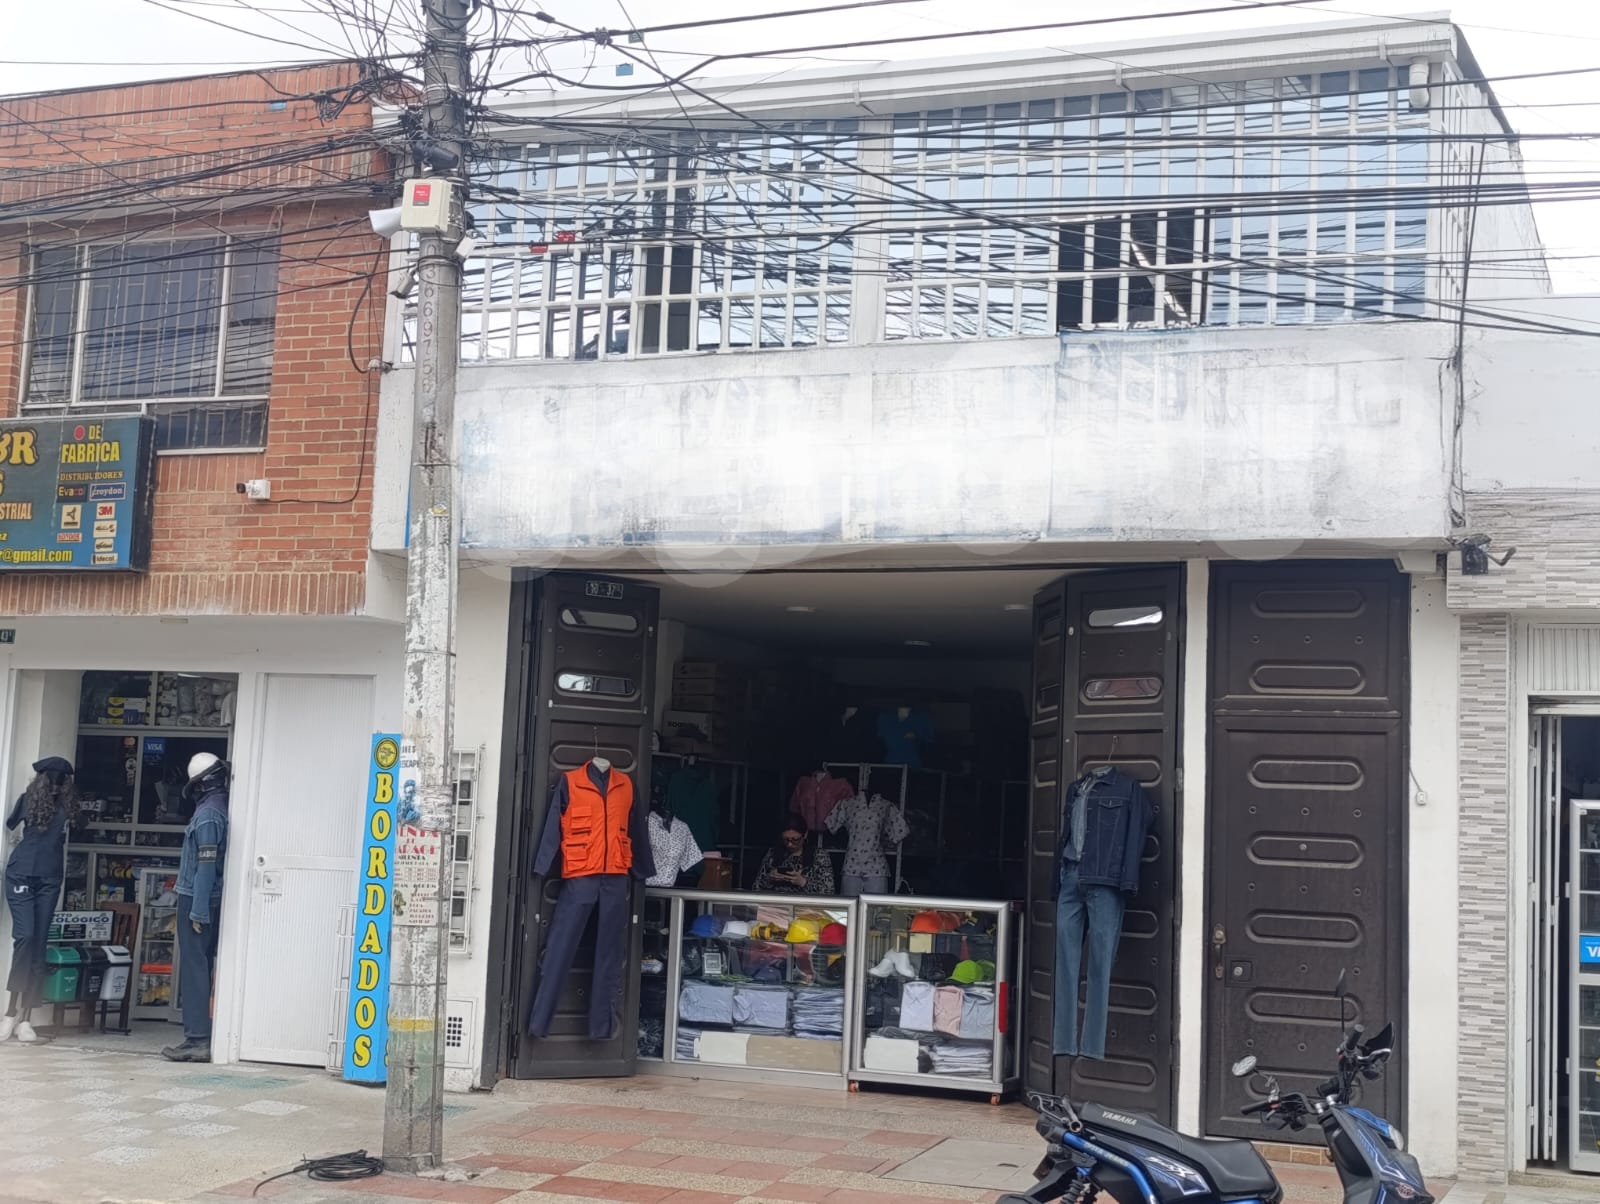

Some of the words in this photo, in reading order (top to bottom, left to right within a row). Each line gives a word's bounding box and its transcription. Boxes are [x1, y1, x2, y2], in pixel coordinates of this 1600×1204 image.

[88, 425, 102, 440] DE
[61, 441, 120, 464] FABRICA
[98, 506, 113, 516] 3M
[353, 771, 395, 1069] BORDADOS
[1102, 1110, 1137, 1126] YAMAHA
